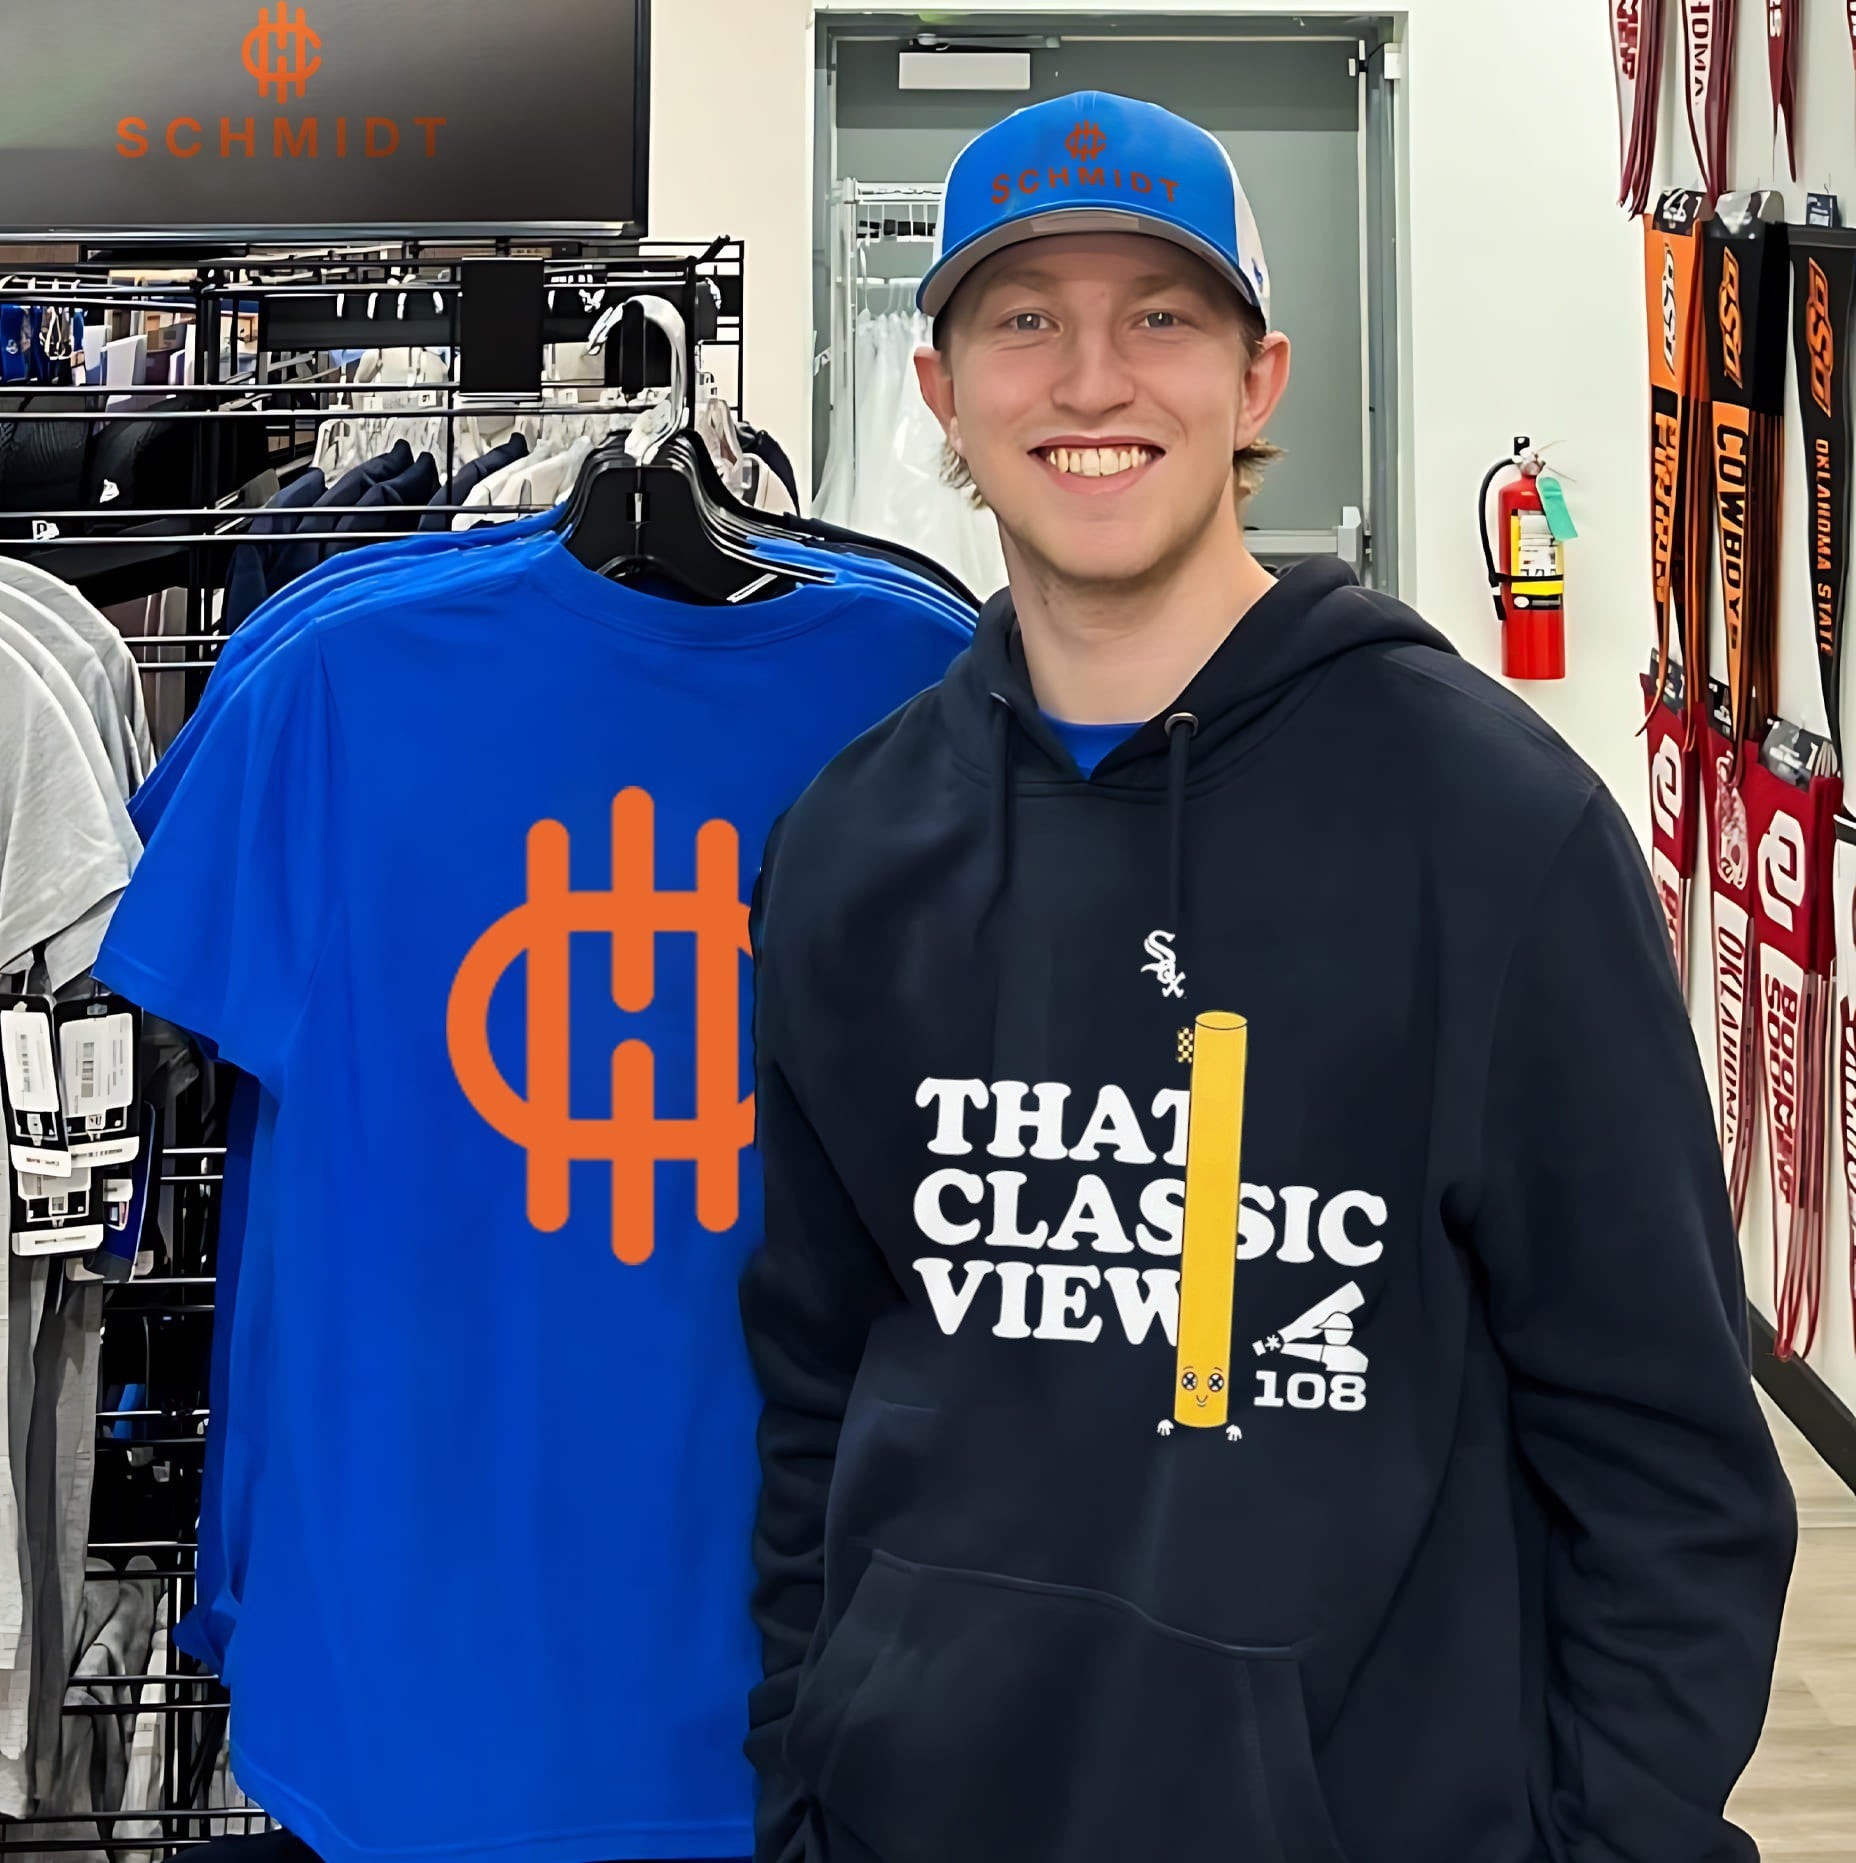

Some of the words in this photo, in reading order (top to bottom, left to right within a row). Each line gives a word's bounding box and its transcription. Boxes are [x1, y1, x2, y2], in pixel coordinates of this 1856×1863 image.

[116, 116, 447, 159] SCHMIDT
[992, 167, 1179, 204] SCHMIDT
[1815, 438, 1832, 571] OKLAHOMA
[1817, 582, 1833, 657] STATE
[1719, 925, 1746, 1145] OKLAHOMA
[916, 1077, 1191, 1166] THAT
[913, 1168, 1388, 1267] CLASSIC
[913, 1257, 1180, 1347] VIEW
[1254, 1370, 1367, 1412] 108
